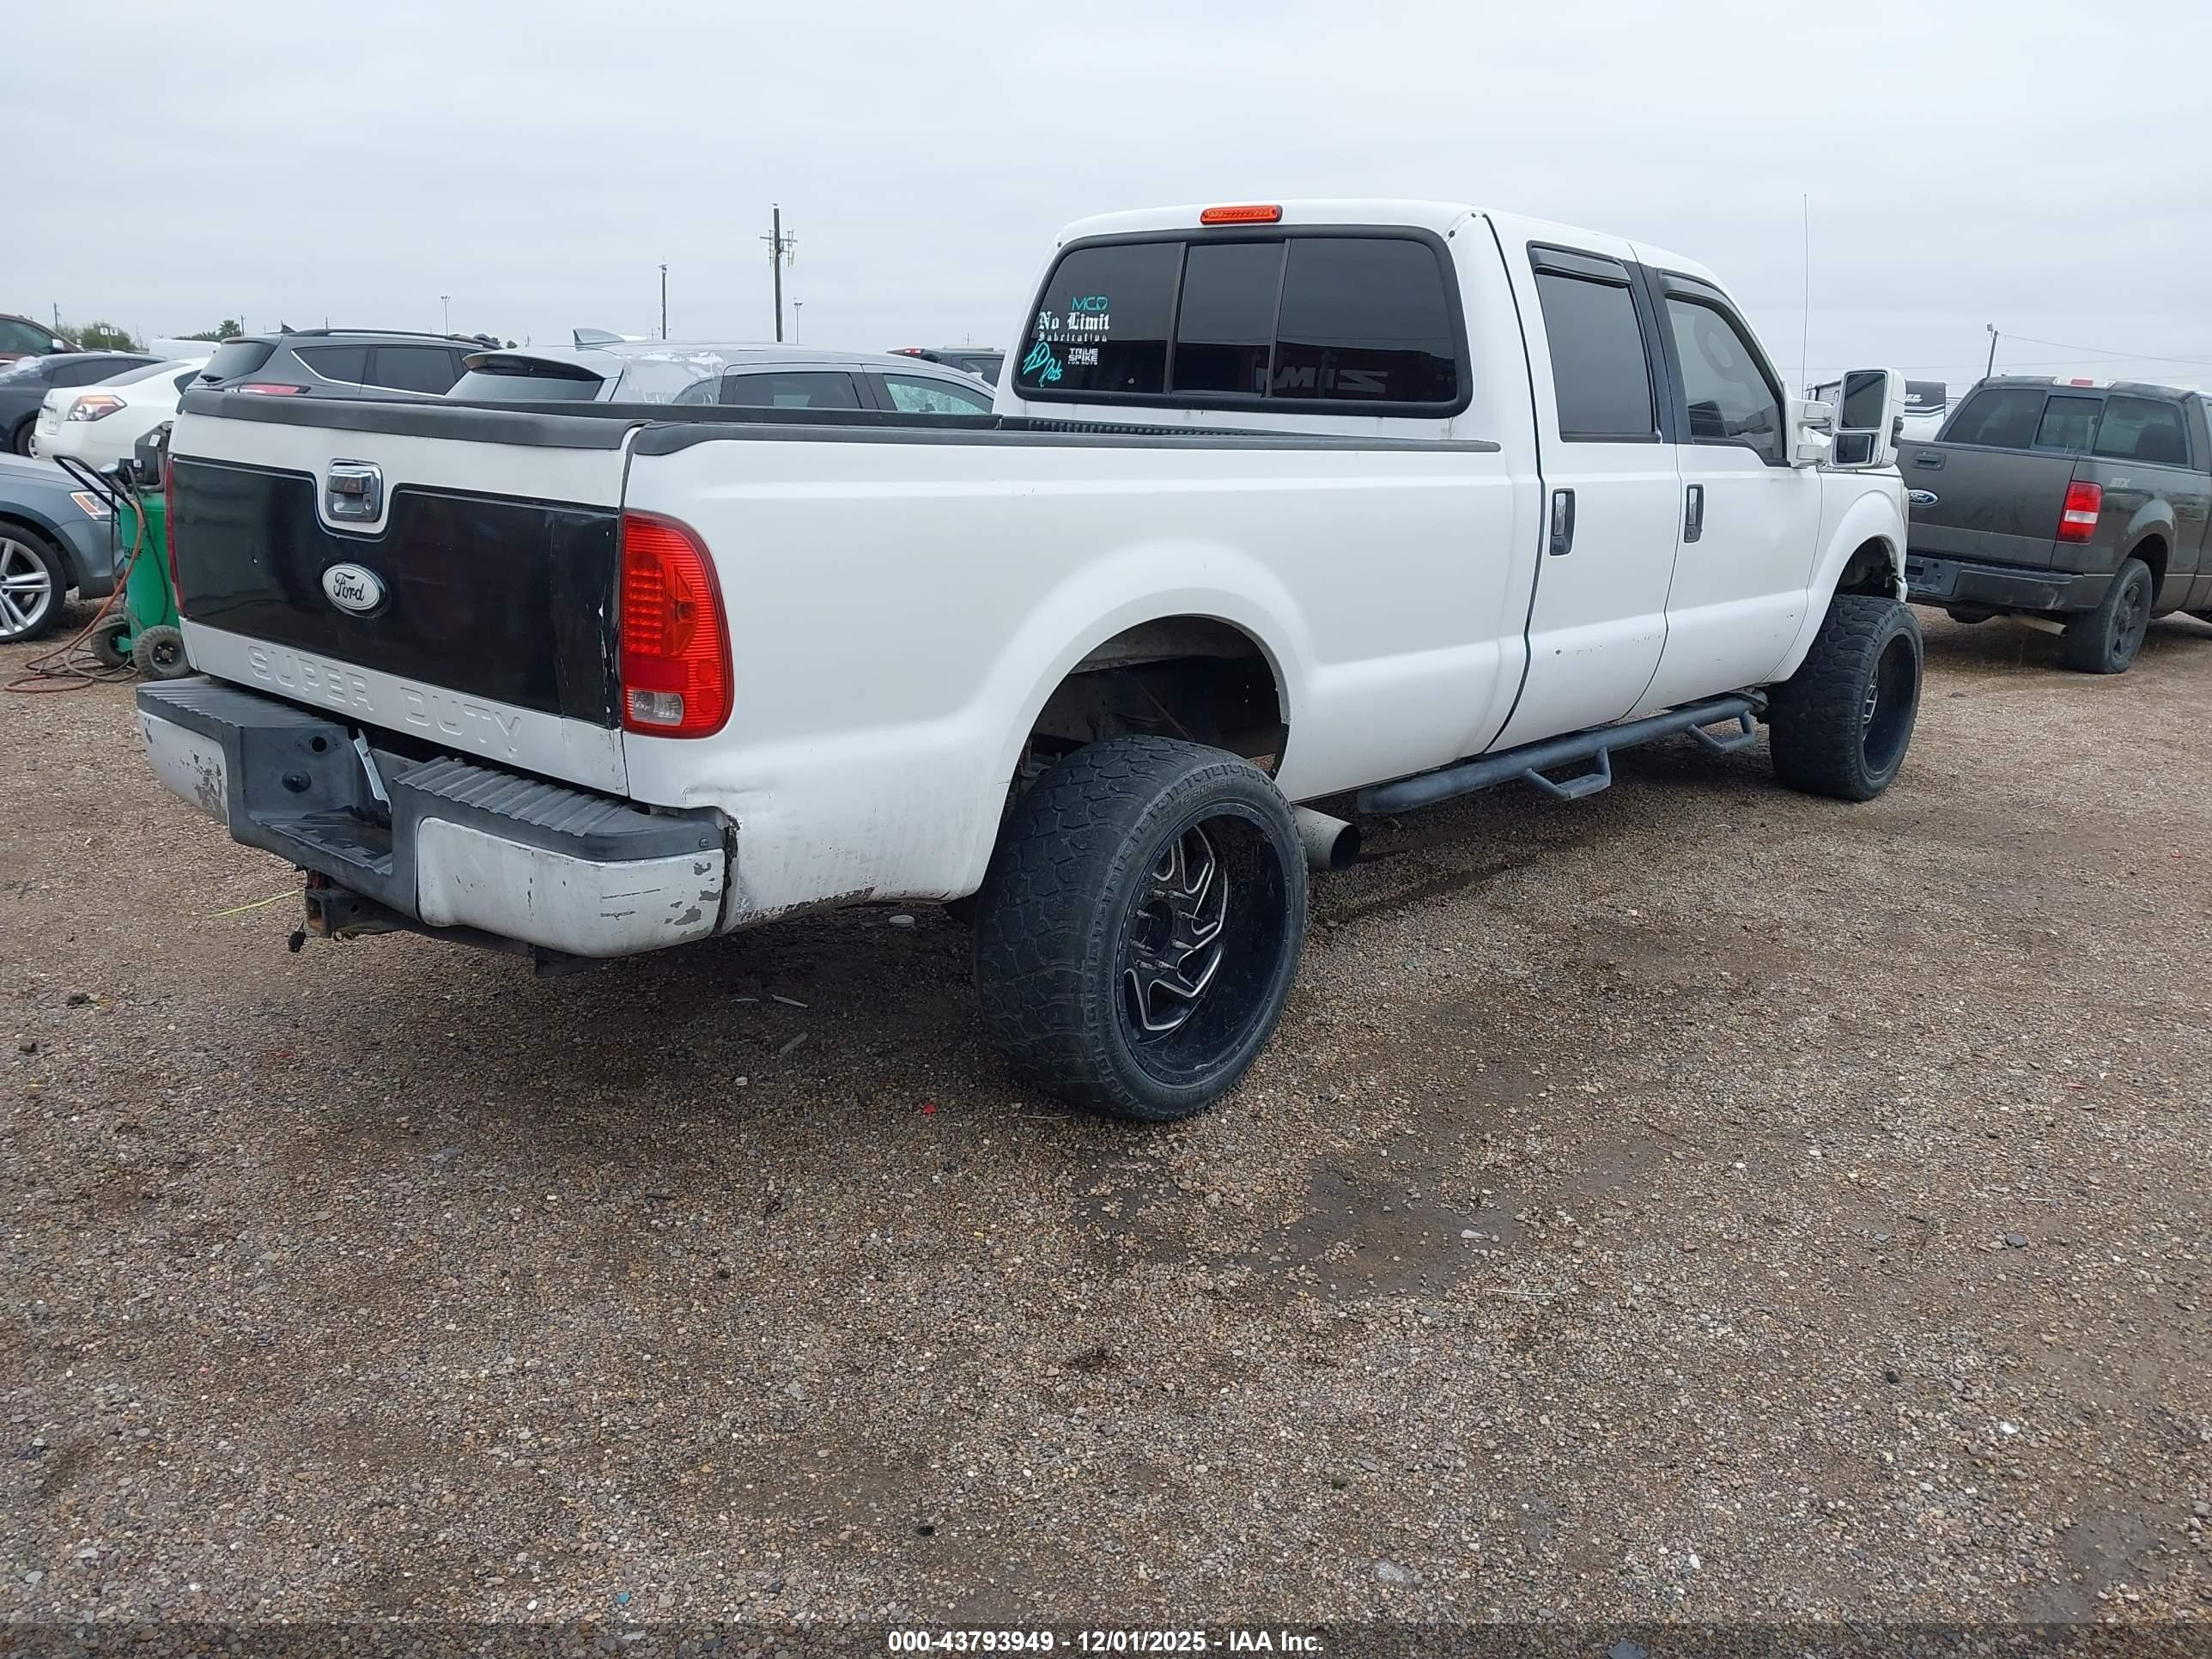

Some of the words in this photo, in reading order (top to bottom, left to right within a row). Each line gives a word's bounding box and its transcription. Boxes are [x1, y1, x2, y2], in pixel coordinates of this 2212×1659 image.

[1037, 310, 1060, 330] No
[1066, 312, 1110, 330] Limit
[1909, 492, 1929, 502] Ford
[332, 571, 365, 602] Ford
[247, 646, 374, 712] SUPER
[399, 686, 522, 757] DUTY
